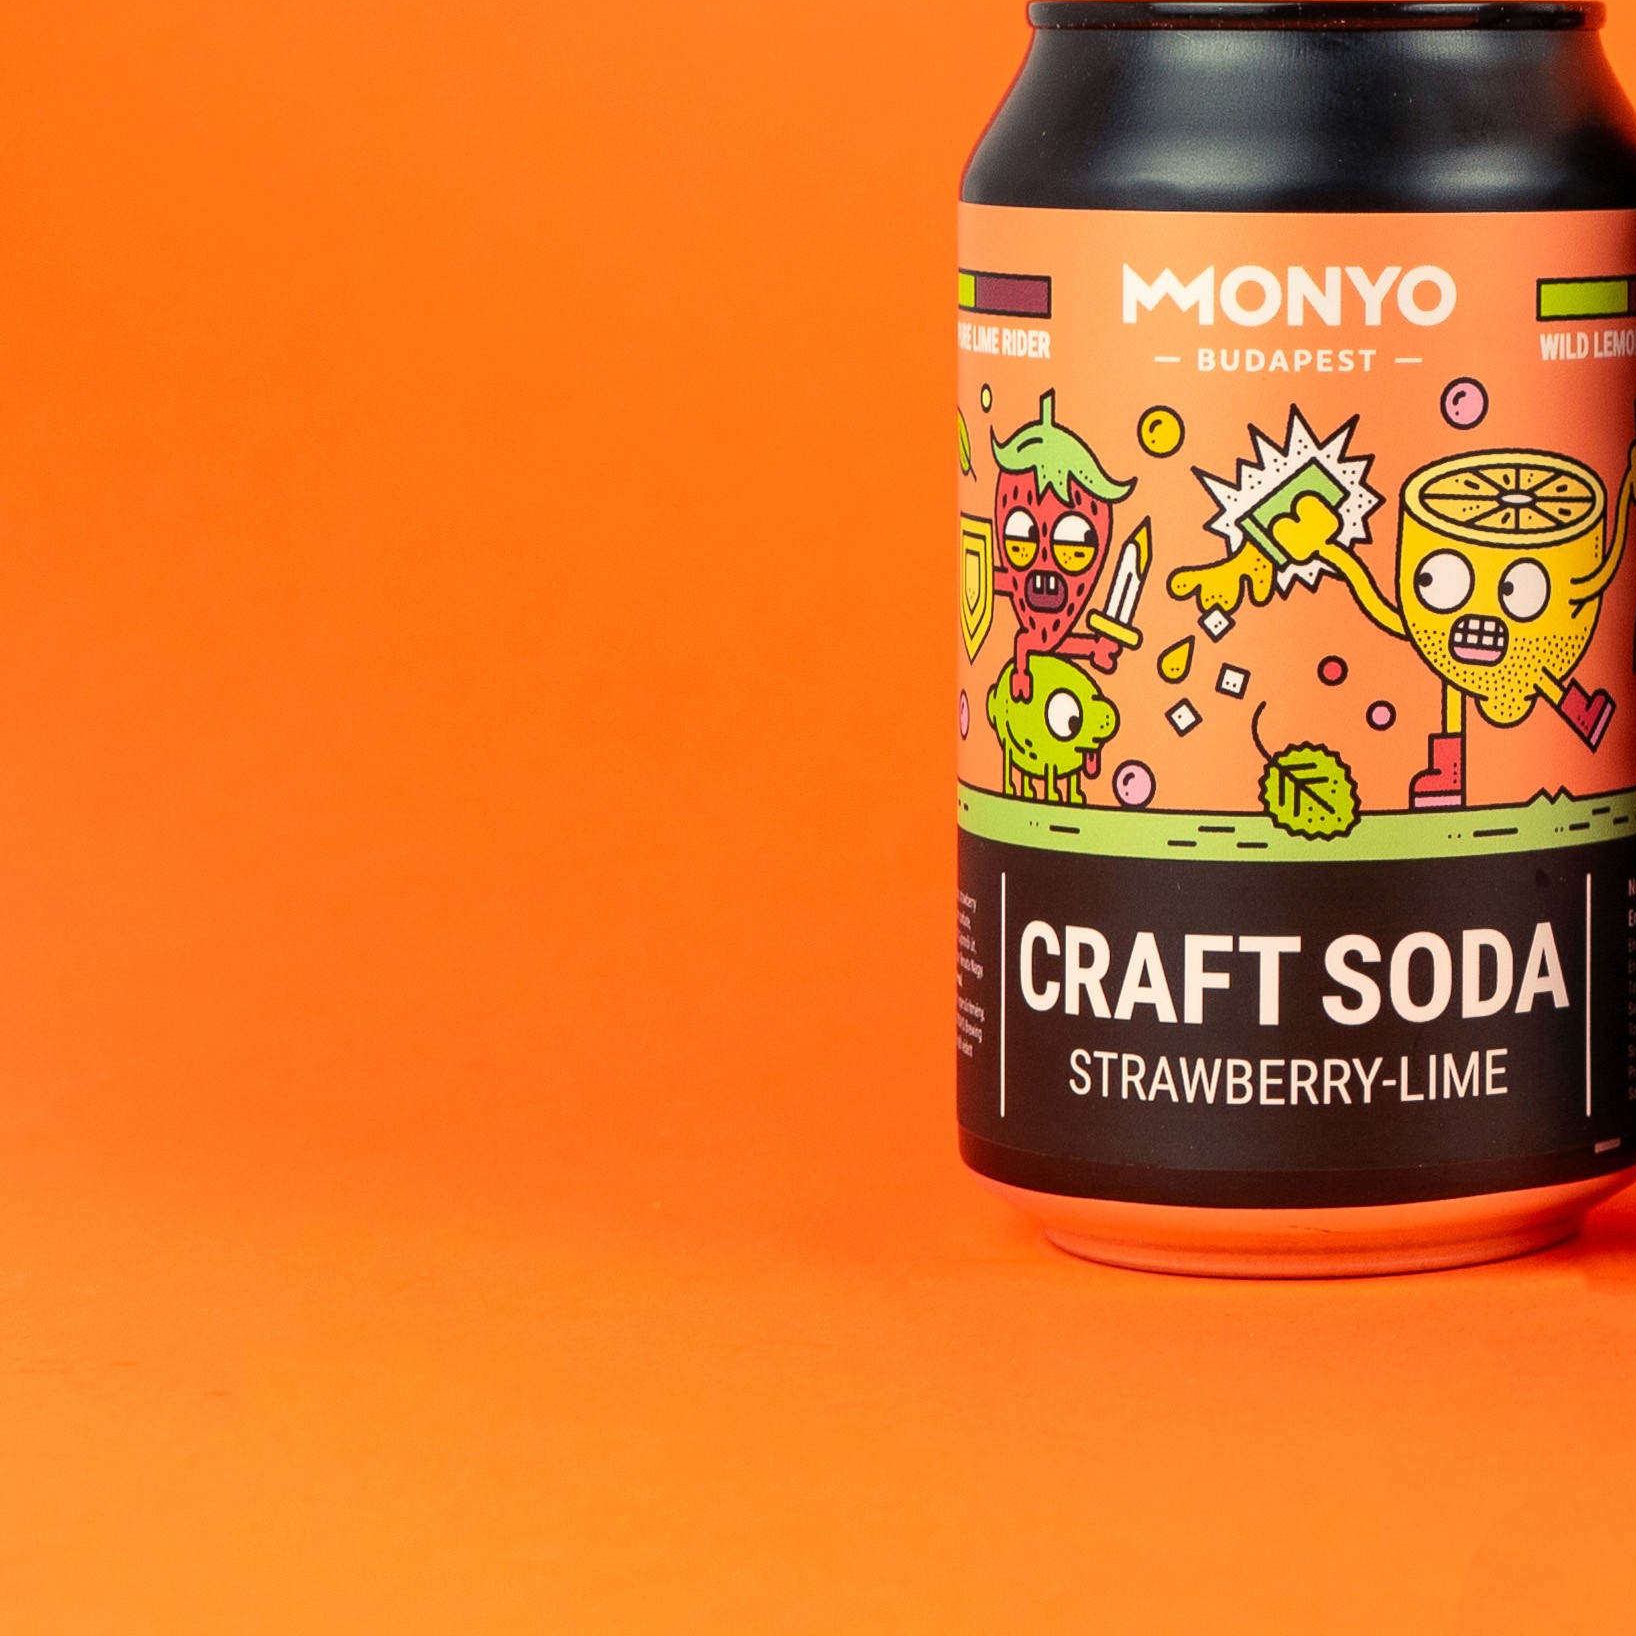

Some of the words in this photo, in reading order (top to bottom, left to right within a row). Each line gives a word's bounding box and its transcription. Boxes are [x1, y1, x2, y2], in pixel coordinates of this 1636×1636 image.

[1122, 263, 1457, 327] MONYO
[973, 325, 1000, 355] LIME
[1002, 327, 1051, 359] RIDER
[1197, 347, 1376, 373] BUDAPEST
[1540, 331, 1589, 361] WILD
[1020, 920, 1301, 1026] CRAFT
[1322, 922, 1569, 1026] SODA
[1069, 1048, 1508, 1105] STRAWBERRY-LIME
